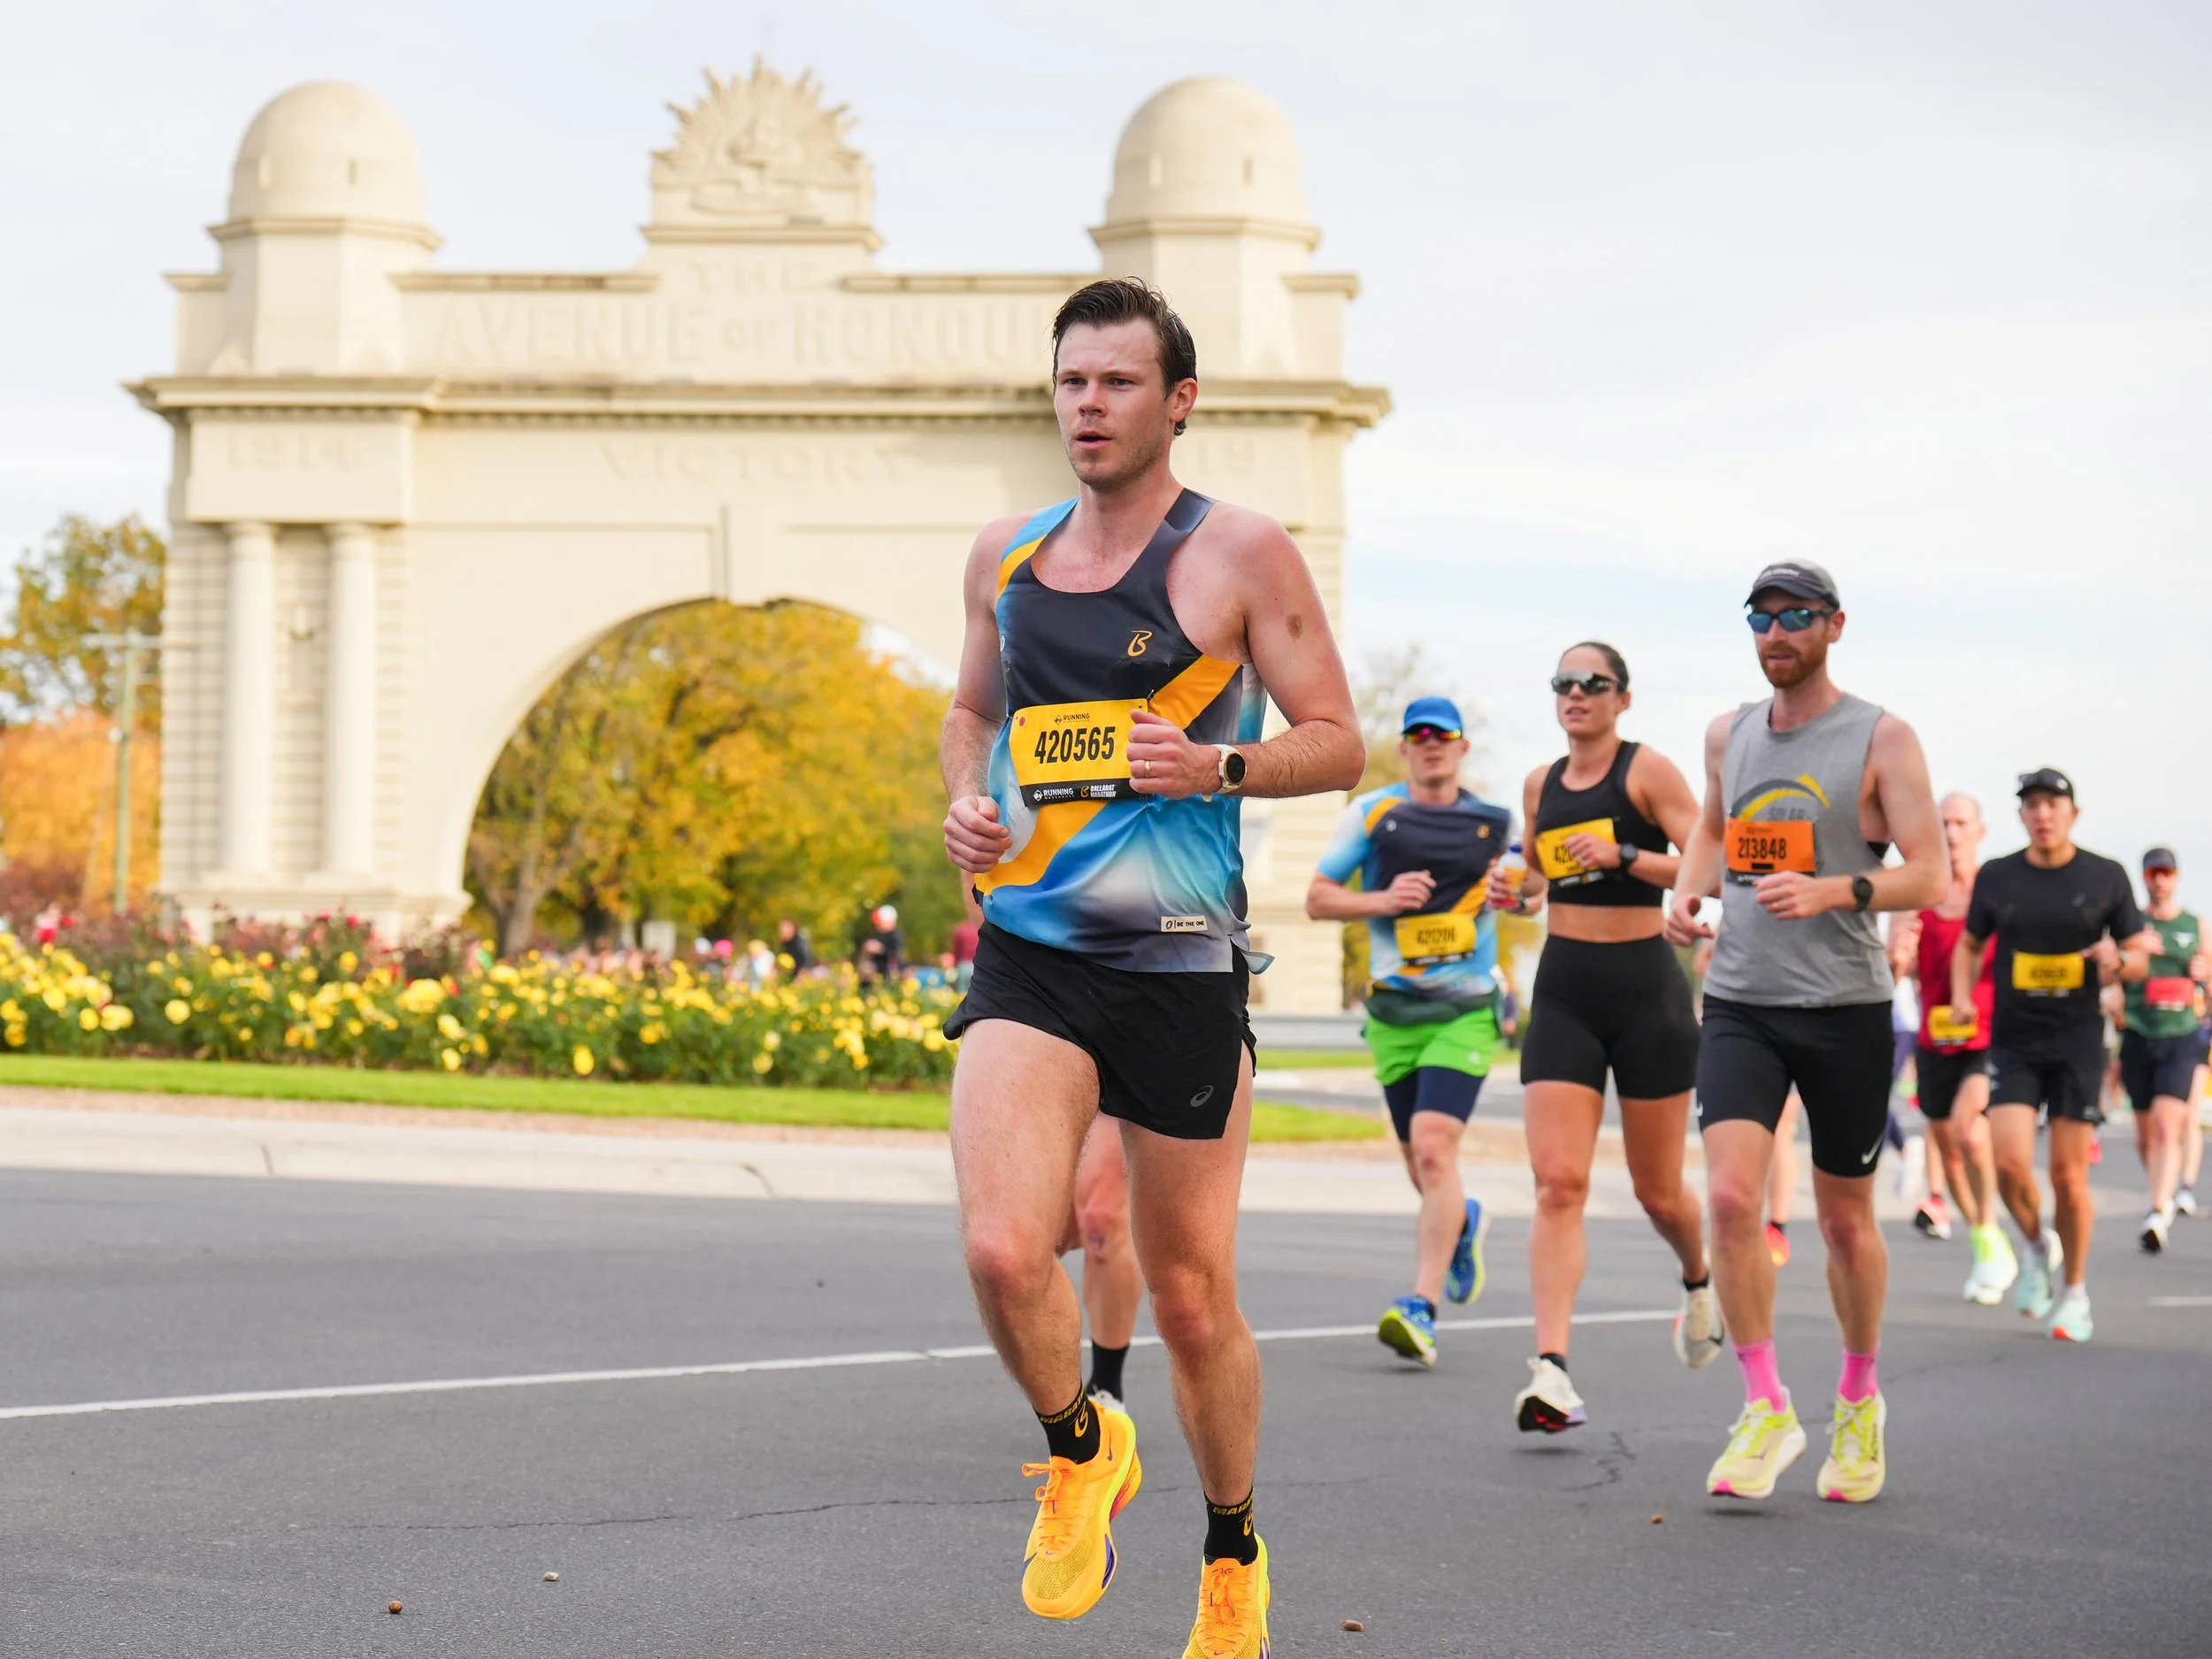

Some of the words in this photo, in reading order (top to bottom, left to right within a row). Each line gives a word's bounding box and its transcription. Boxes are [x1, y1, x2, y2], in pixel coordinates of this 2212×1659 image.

[686, 258, 820, 294] THE
[434, 298, 709, 363] AVENUE
[793, 302, 1047, 365] HONOU
[227, 430, 357, 469] 1914
[597, 438, 910, 483] VICTORY
[1034, 726, 1116, 764] 420565
[1044, 787, 1074, 796] RUNNING
[1738, 837, 1786, 859] 213848
